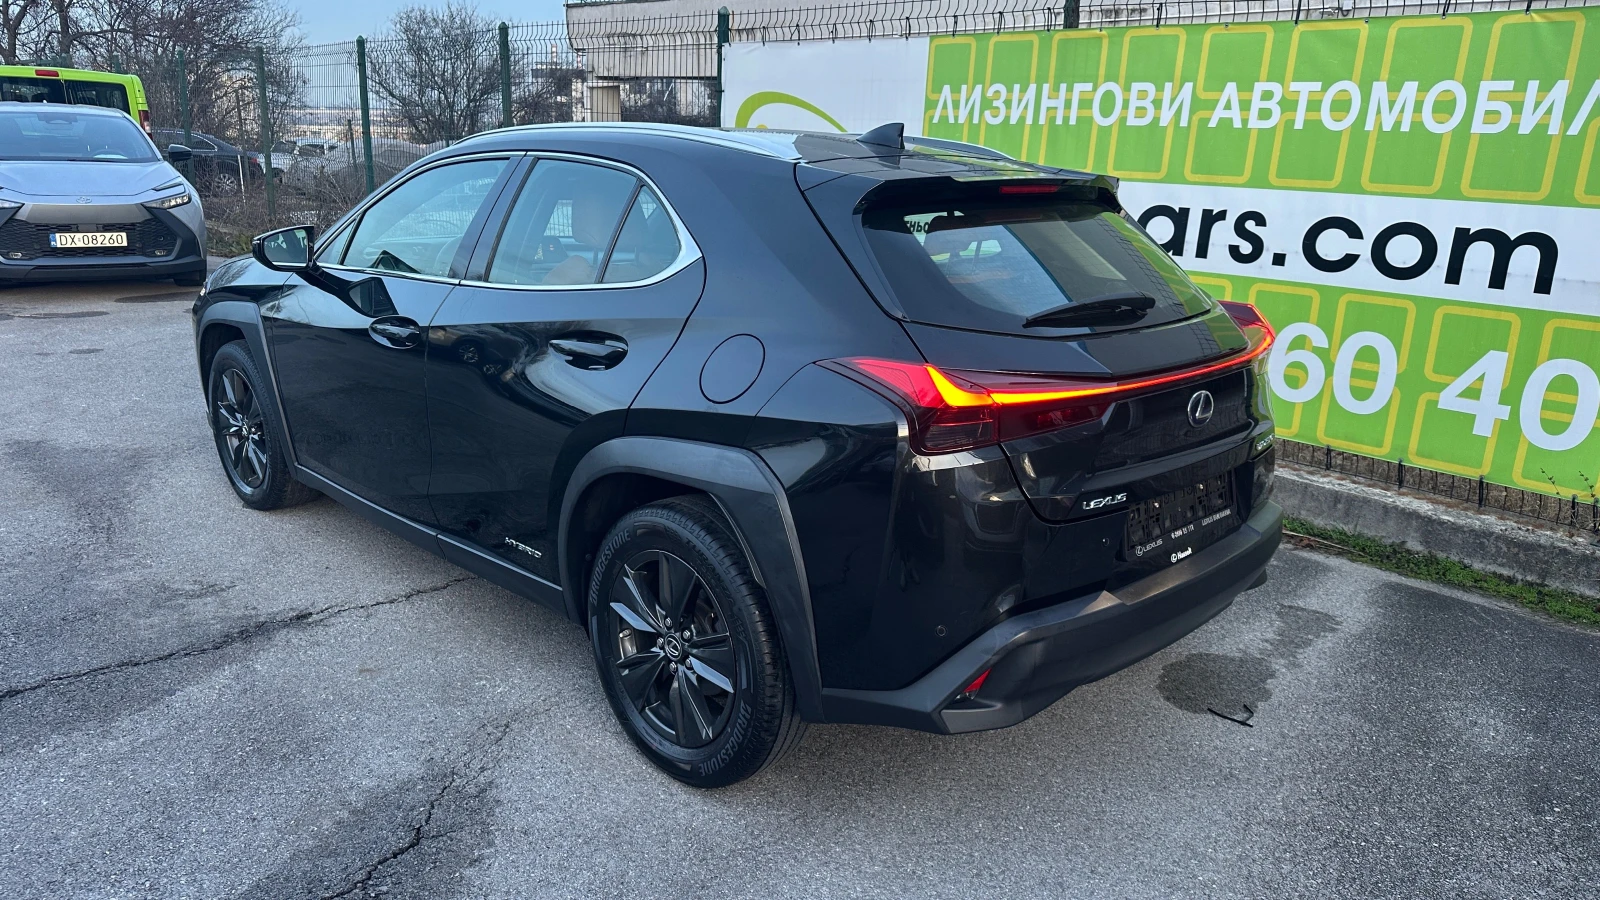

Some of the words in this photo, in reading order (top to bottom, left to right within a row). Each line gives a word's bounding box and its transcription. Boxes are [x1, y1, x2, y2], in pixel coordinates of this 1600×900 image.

[932, 81, 1194, 127] ЛИЗИНГОВИ
[59, 234, 77, 246] DX
[82, 234, 123, 246] 08260
[1268, 321, 1398, 415] 60
[1437, 349, 1600, 451] 40
[1083, 493, 1127, 509] LEXUS
[504, 536, 542, 559] HYBRID
[1142, 538, 1163, 552] LEXUS
[590, 528, 631, 607] BRIDGESTONE
[698, 699, 752, 776] BRIDGESTONE
